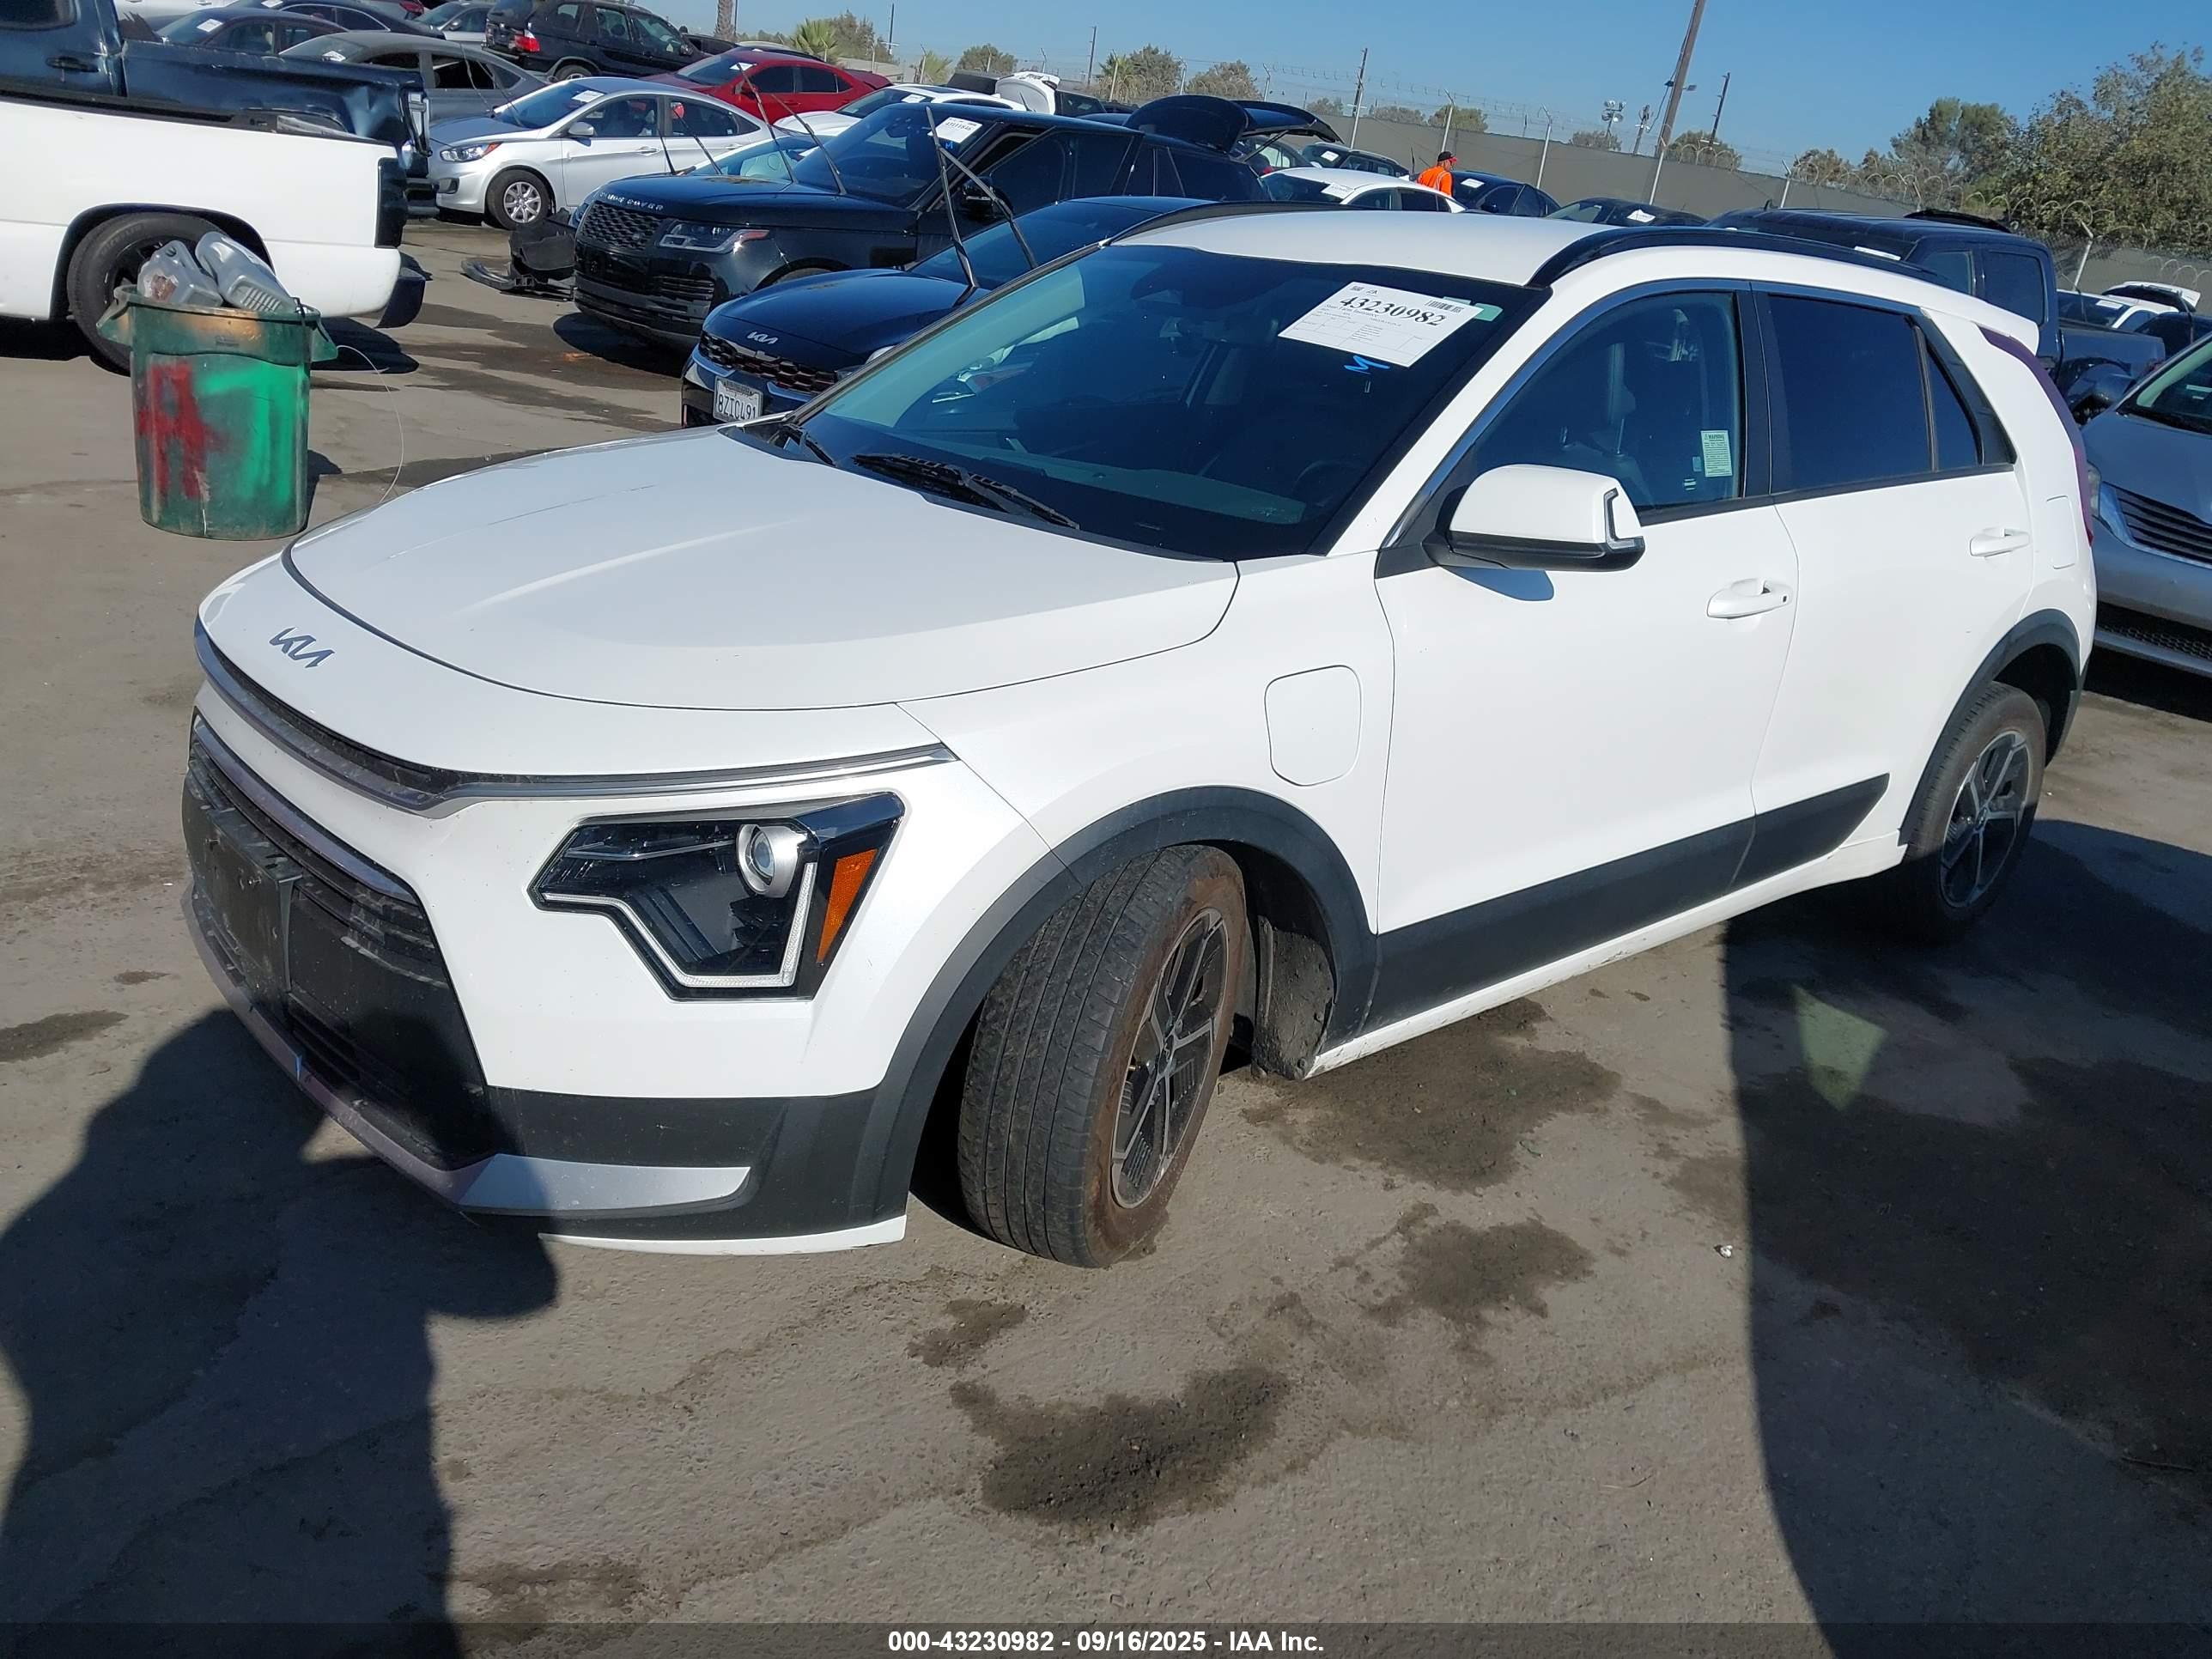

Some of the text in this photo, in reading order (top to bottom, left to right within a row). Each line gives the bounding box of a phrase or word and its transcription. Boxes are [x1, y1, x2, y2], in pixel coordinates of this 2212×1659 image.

[1340, 296, 1446, 326] 43230982
[747, 331, 778, 344] KIA
[269, 627, 336, 668] KIA
